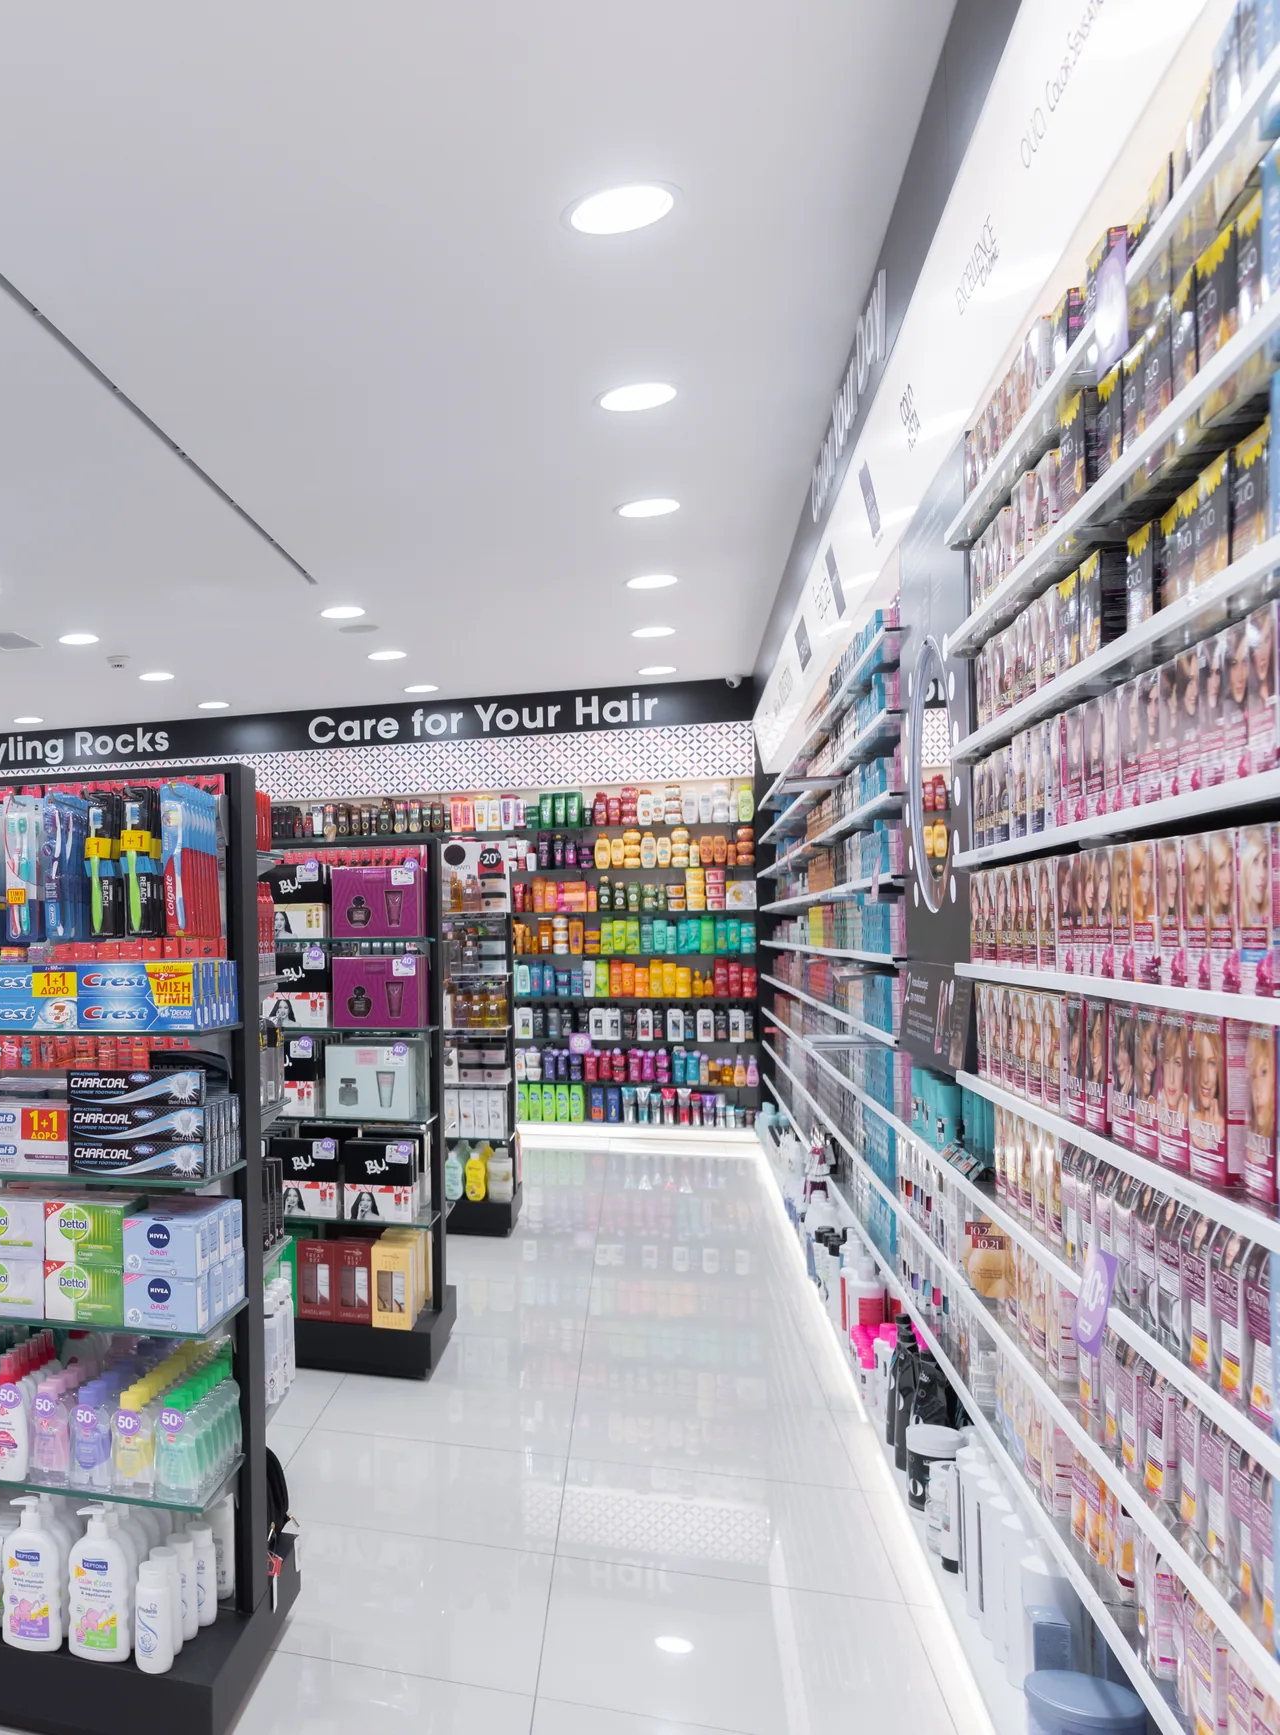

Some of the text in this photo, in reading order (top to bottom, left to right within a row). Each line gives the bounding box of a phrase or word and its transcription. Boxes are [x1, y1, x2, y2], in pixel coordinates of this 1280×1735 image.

[831, 356, 858, 459] Your
[856, 269, 887, 395] Day
[307, 693, 659, 744] Care for Your Hair
[74, 727, 170, 757] Rocks
[478, 851, 501, 866] -20%
[165, 873, 175, 917] Colgate
[43, 973, 68, 987] 1+1
[81, 973, 147, 988] Crest
[40, 986, 70, 995] ΔΩΡΟ
[156, 981, 191, 993] ΜΙΣΗ
[156, 993, 191, 1005] ΤΙΜΗ
[83, 1005, 148, 1021] Crest
[1161, 1014, 1185, 1027] GARNIER
[1192, 1021, 1221, 1034] GARNIER
[70, 1078, 129, 1089] CHARCOAL
[29, 1110, 59, 1132] 1+1
[73, 1112, 132, 1125] CHARCOAL
[30, 1130, 59, 1141] ΔΩΡΟ
[74, 1147, 133, 1160] CHARCOAL
[291, 1155, 315, 1171] B.U.
[365, 1157, 389, 1175] B.U.
[46, 1203, 58, 1215] 3+1
[59, 1218, 88, 1231] Dettol
[977, 1239, 999, 1249] 10.21
[46, 1262, 58, 1273] 3+1
[1182, 1253, 1206, 1279] CASTING
[59, 1276, 87, 1289] Dettol
[1212, 1269, 1238, 1296] CASTING
[301, 1309, 332, 1317] SANDALWOOD
[339, 1311, 370, 1320] SANDALWOOD
[16, 1552, 39, 1561] SEPTONA
[83, 1561, 107, 1570] SEPTONA
